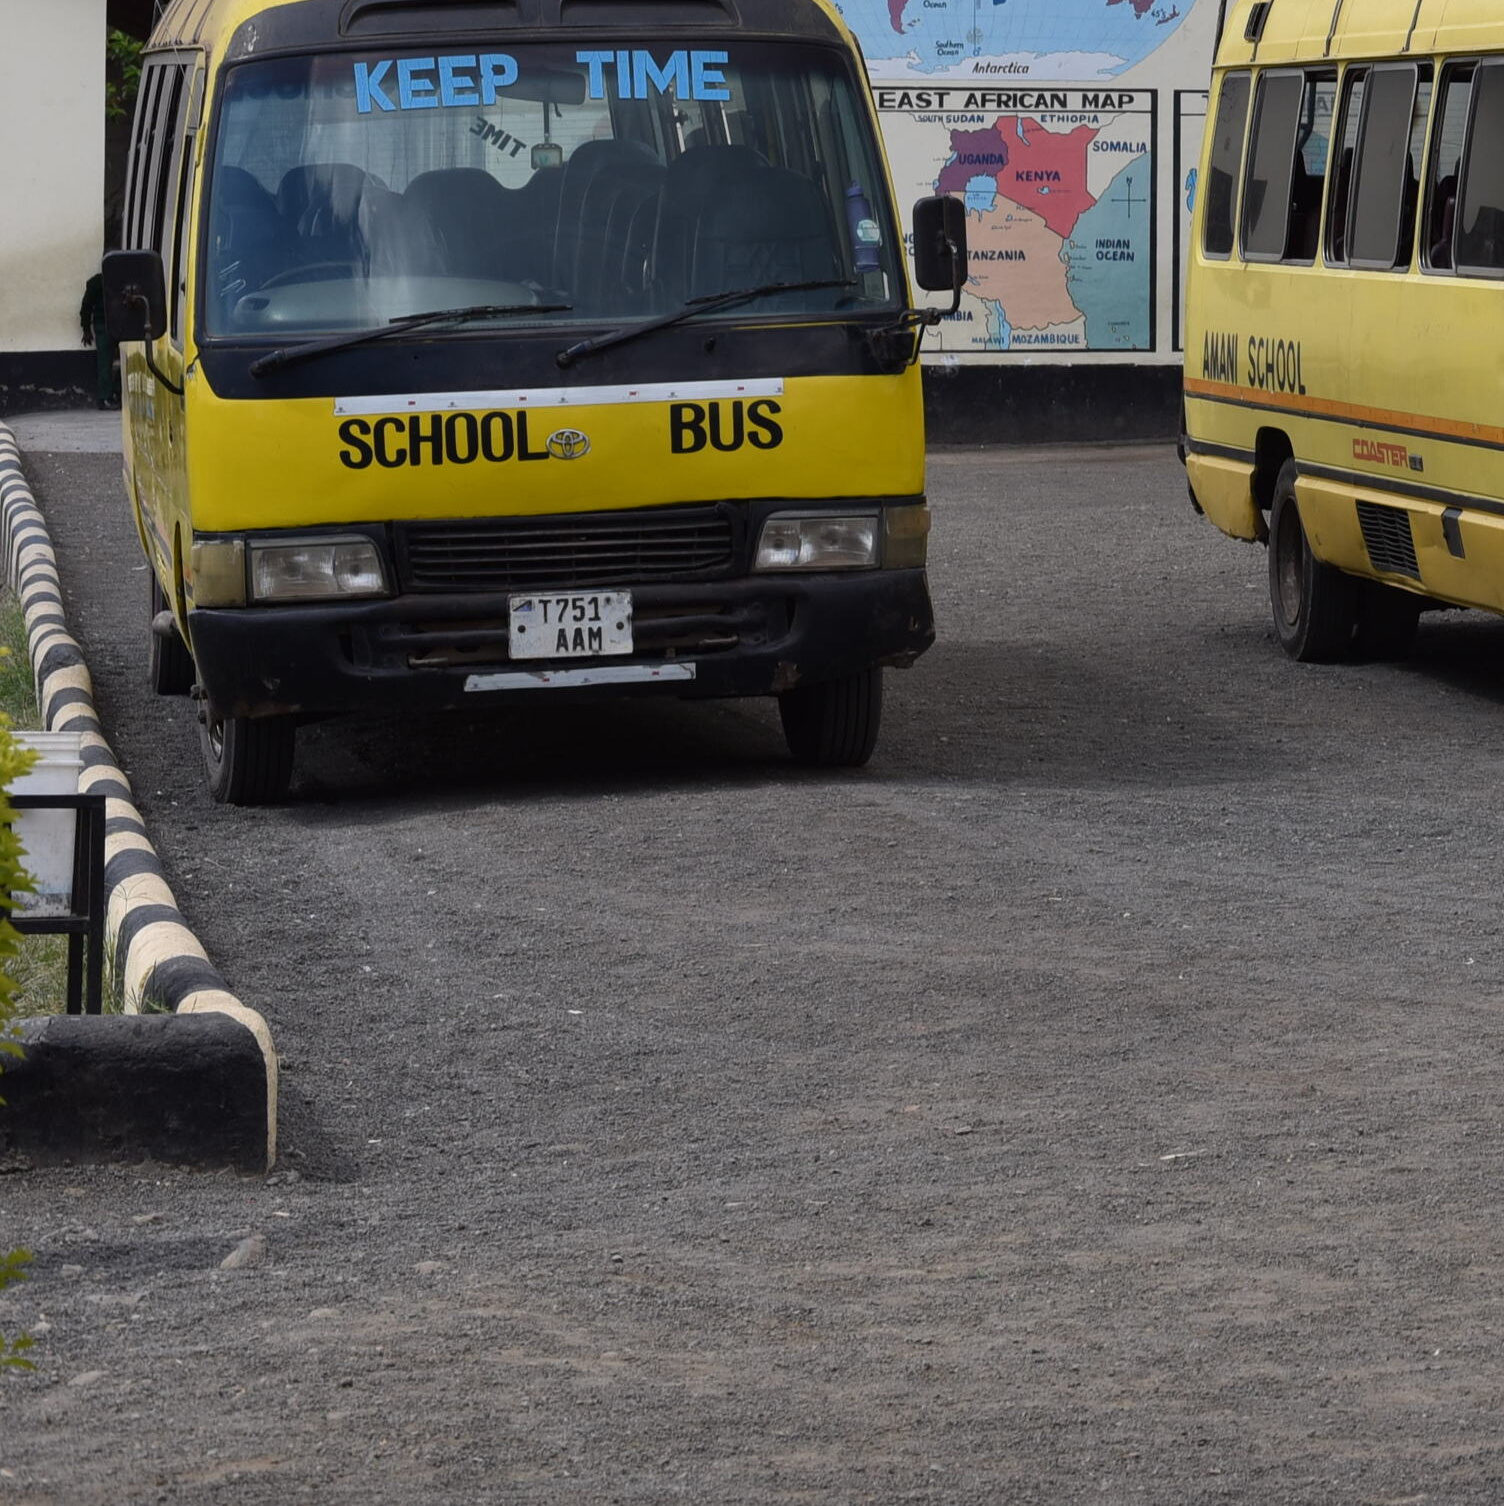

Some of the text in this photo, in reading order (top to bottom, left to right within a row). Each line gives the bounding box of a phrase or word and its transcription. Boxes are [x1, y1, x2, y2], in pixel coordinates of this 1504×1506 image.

[923, 0, 947, 9] Ocean
[935, 40, 964, 50] Southern
[937, 48, 959, 56] Ocean
[972, 61, 1030, 75] Antarctica
[353, 49, 731, 113] KEEP TIME
[878, 92, 1135, 109] EAST AFRICAN MAP
[917, 114, 985, 124] SOUTH SUDAN
[1040, 114, 1099, 124] ETHIOPIA
[1092, 140, 1148, 153] SOMALIA
[958, 153, 1004, 166] UGANDA
[1015, 170, 1061, 182] KENYA
[1095, 238, 1131, 250] INDIAN
[967, 250, 1026, 261] TANZANIA
[1096, 251, 1135, 263] OCEAN
[971, 336, 1005, 344] MALAWI
[1012, 334, 1080, 345] MOZAMBIQUE
[1203, 329, 1306, 396] AMANI SCHOOL
[338, 398, 784, 470] SCHOOL BUS
[1352, 438, 1409, 469] COASTER
[555, 626, 603, 653] AAM
